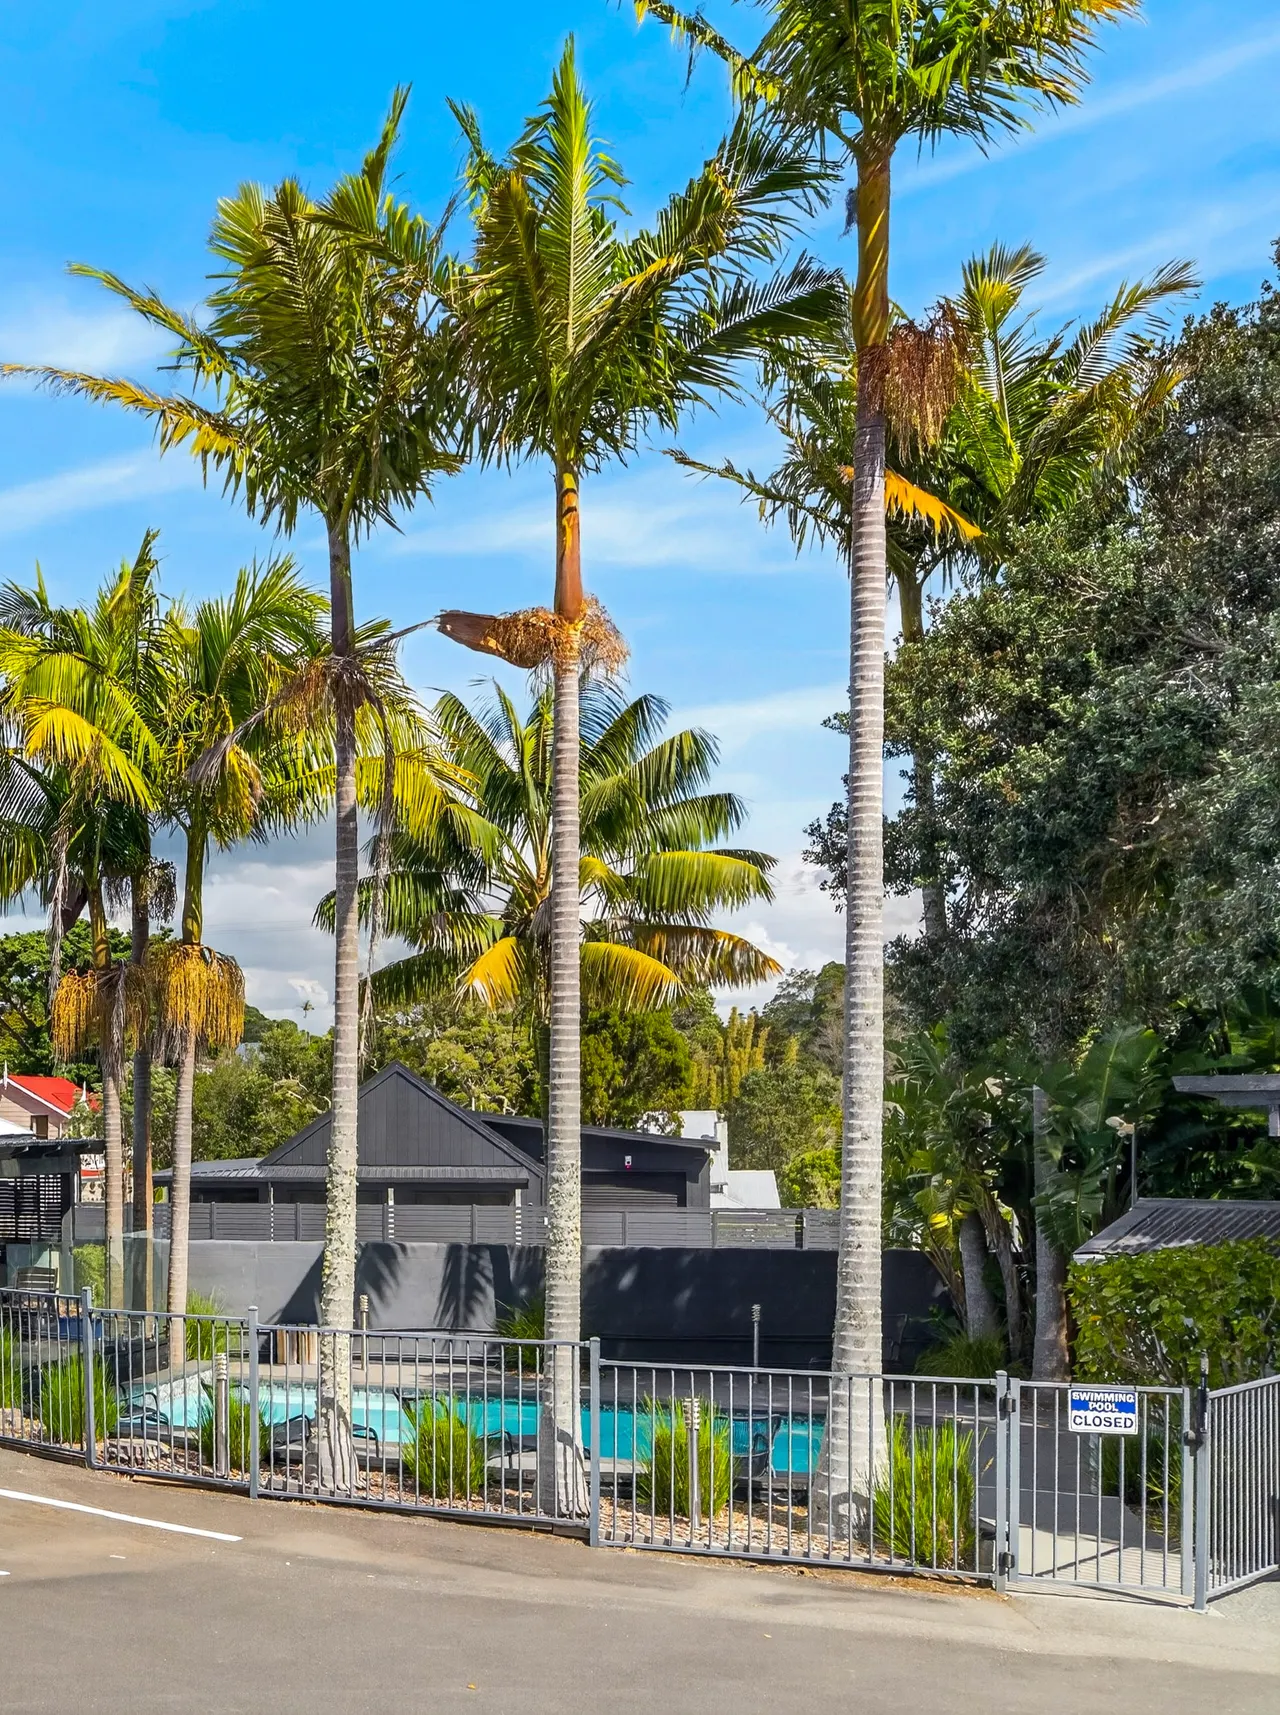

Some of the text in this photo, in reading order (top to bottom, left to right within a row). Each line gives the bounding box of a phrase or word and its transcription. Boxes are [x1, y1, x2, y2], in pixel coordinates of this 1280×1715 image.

[1072, 1391, 1135, 1403] SWIMMING
[1088, 1402, 1119, 1412] POOL
[1073, 1415, 1134, 1429] CLOSED
